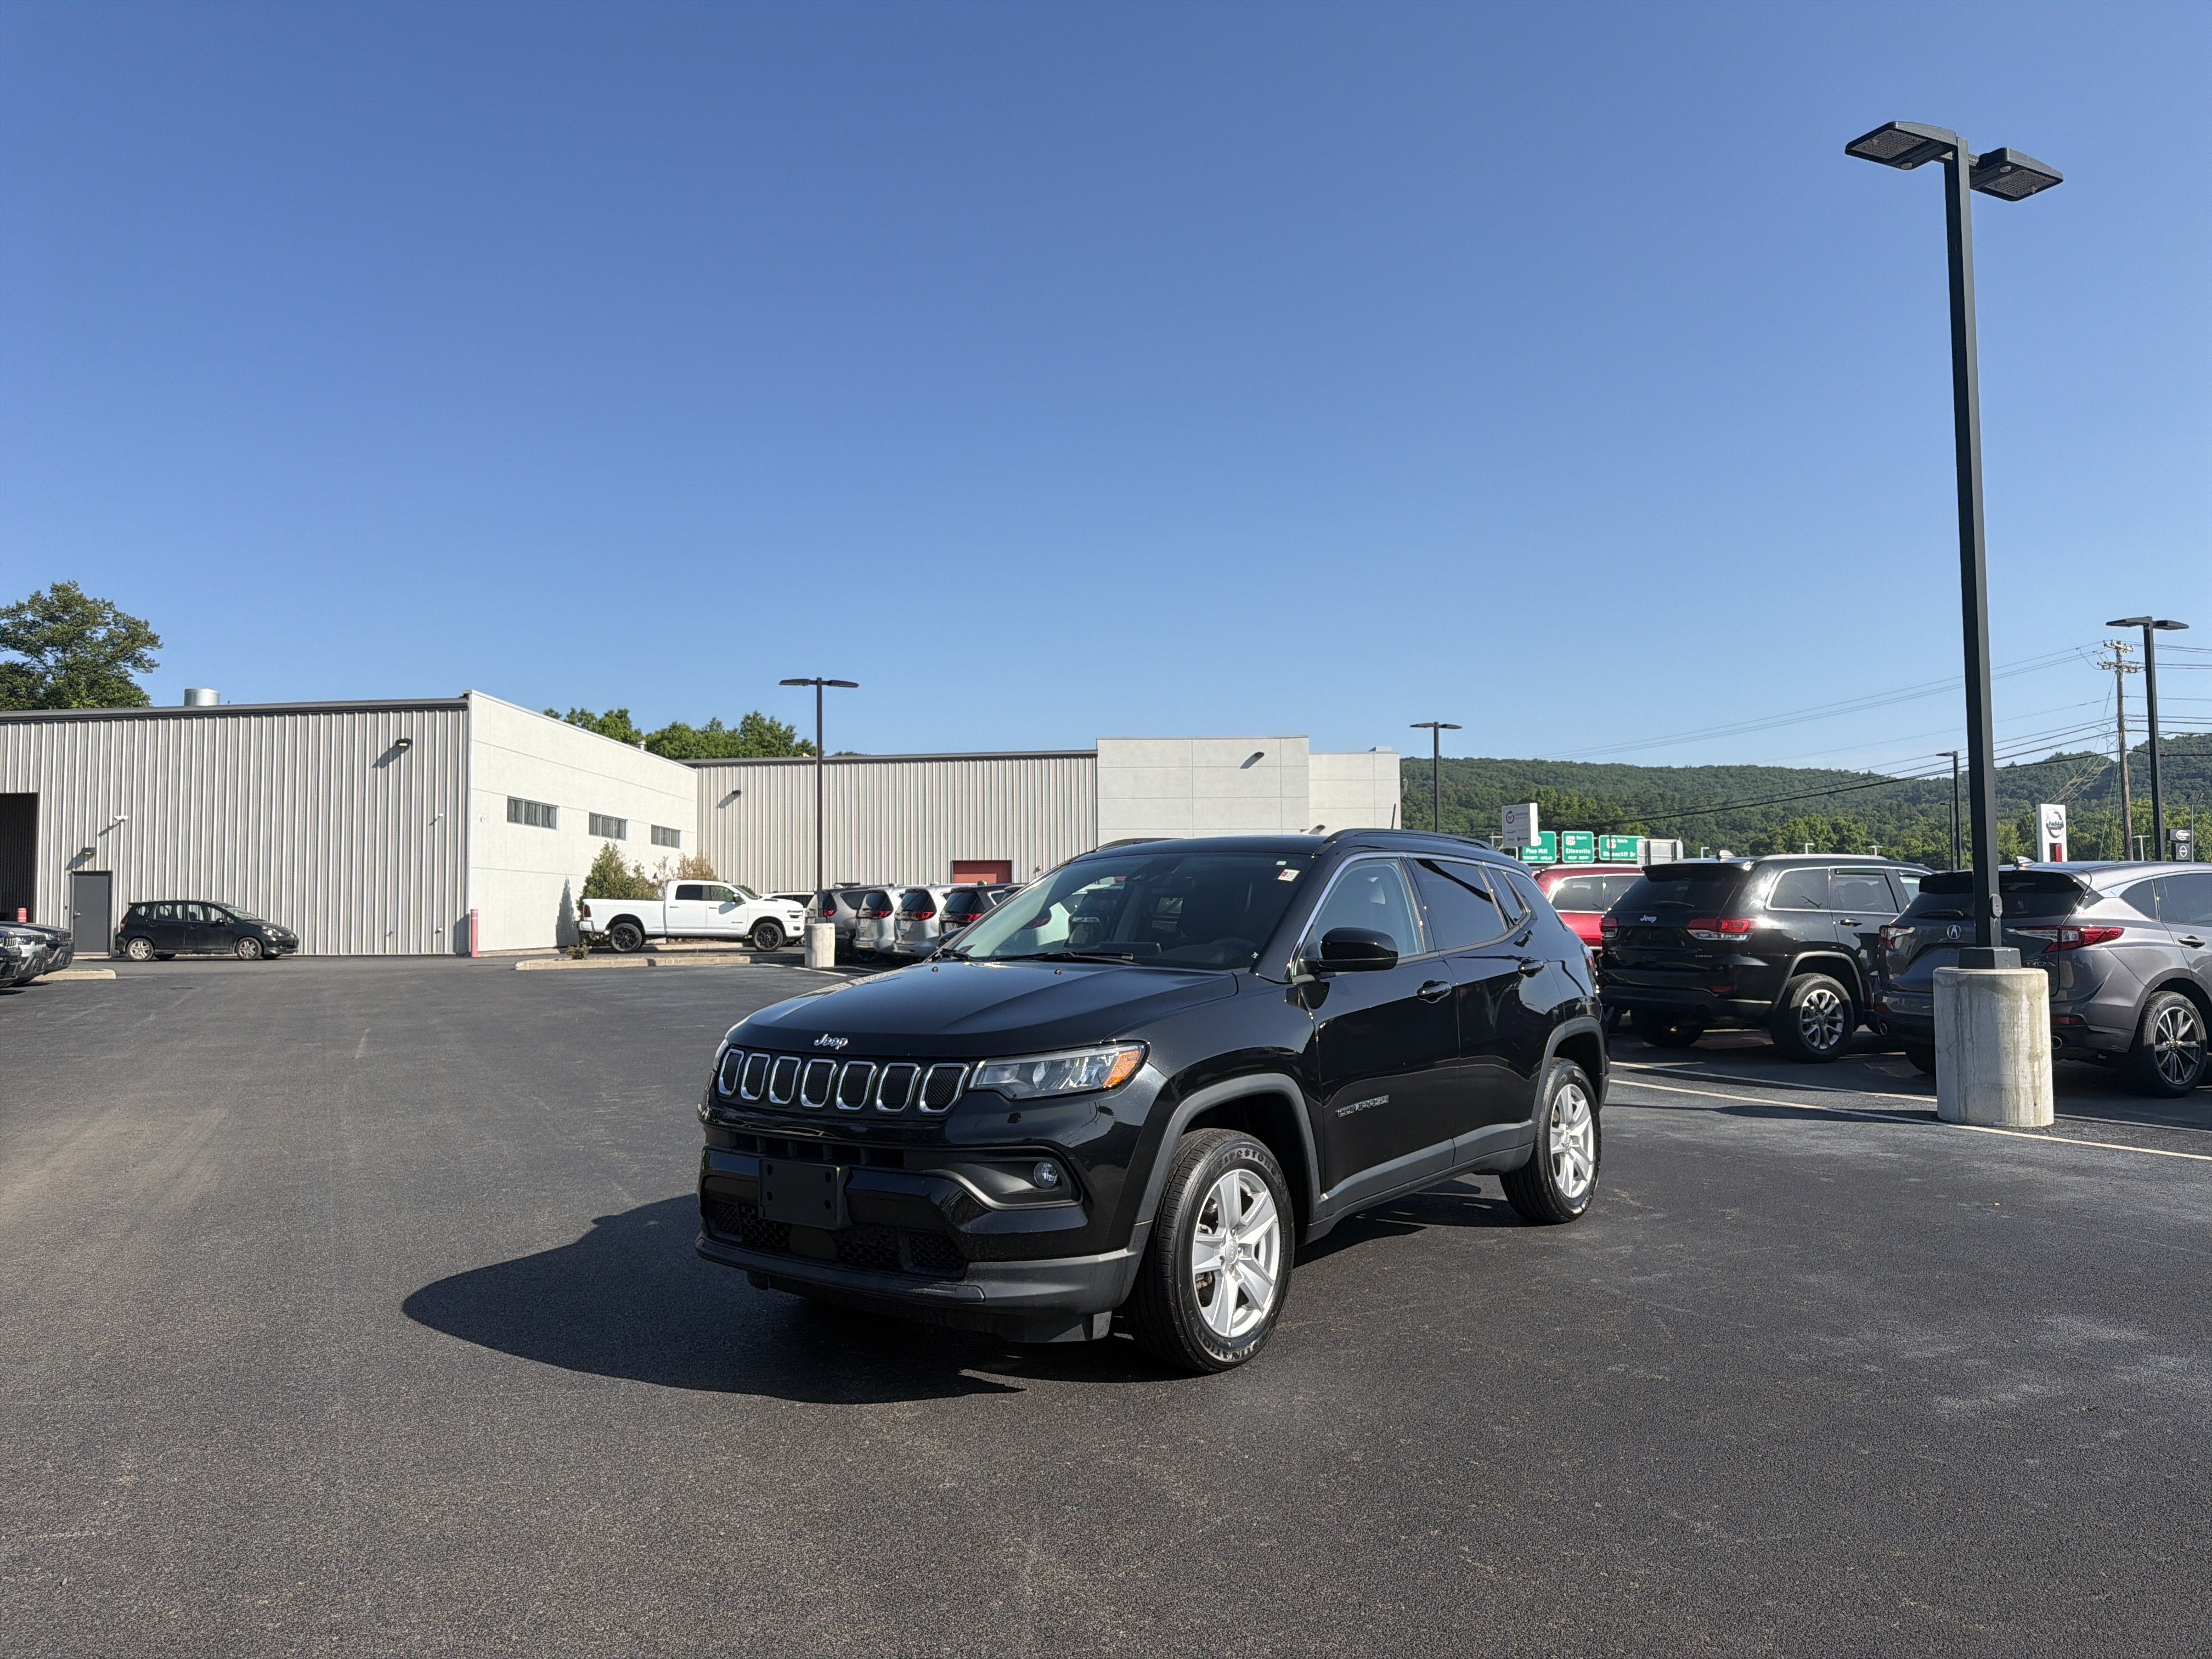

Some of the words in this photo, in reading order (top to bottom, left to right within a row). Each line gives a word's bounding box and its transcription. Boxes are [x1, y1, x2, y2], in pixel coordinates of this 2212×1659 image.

[1640, 914, 1657, 923] Jeep
[814, 1034, 848, 1050] Jeep
[1335, 1094, 1389, 1118] COMPASS
[1216, 1149, 1277, 1177] Firestone
